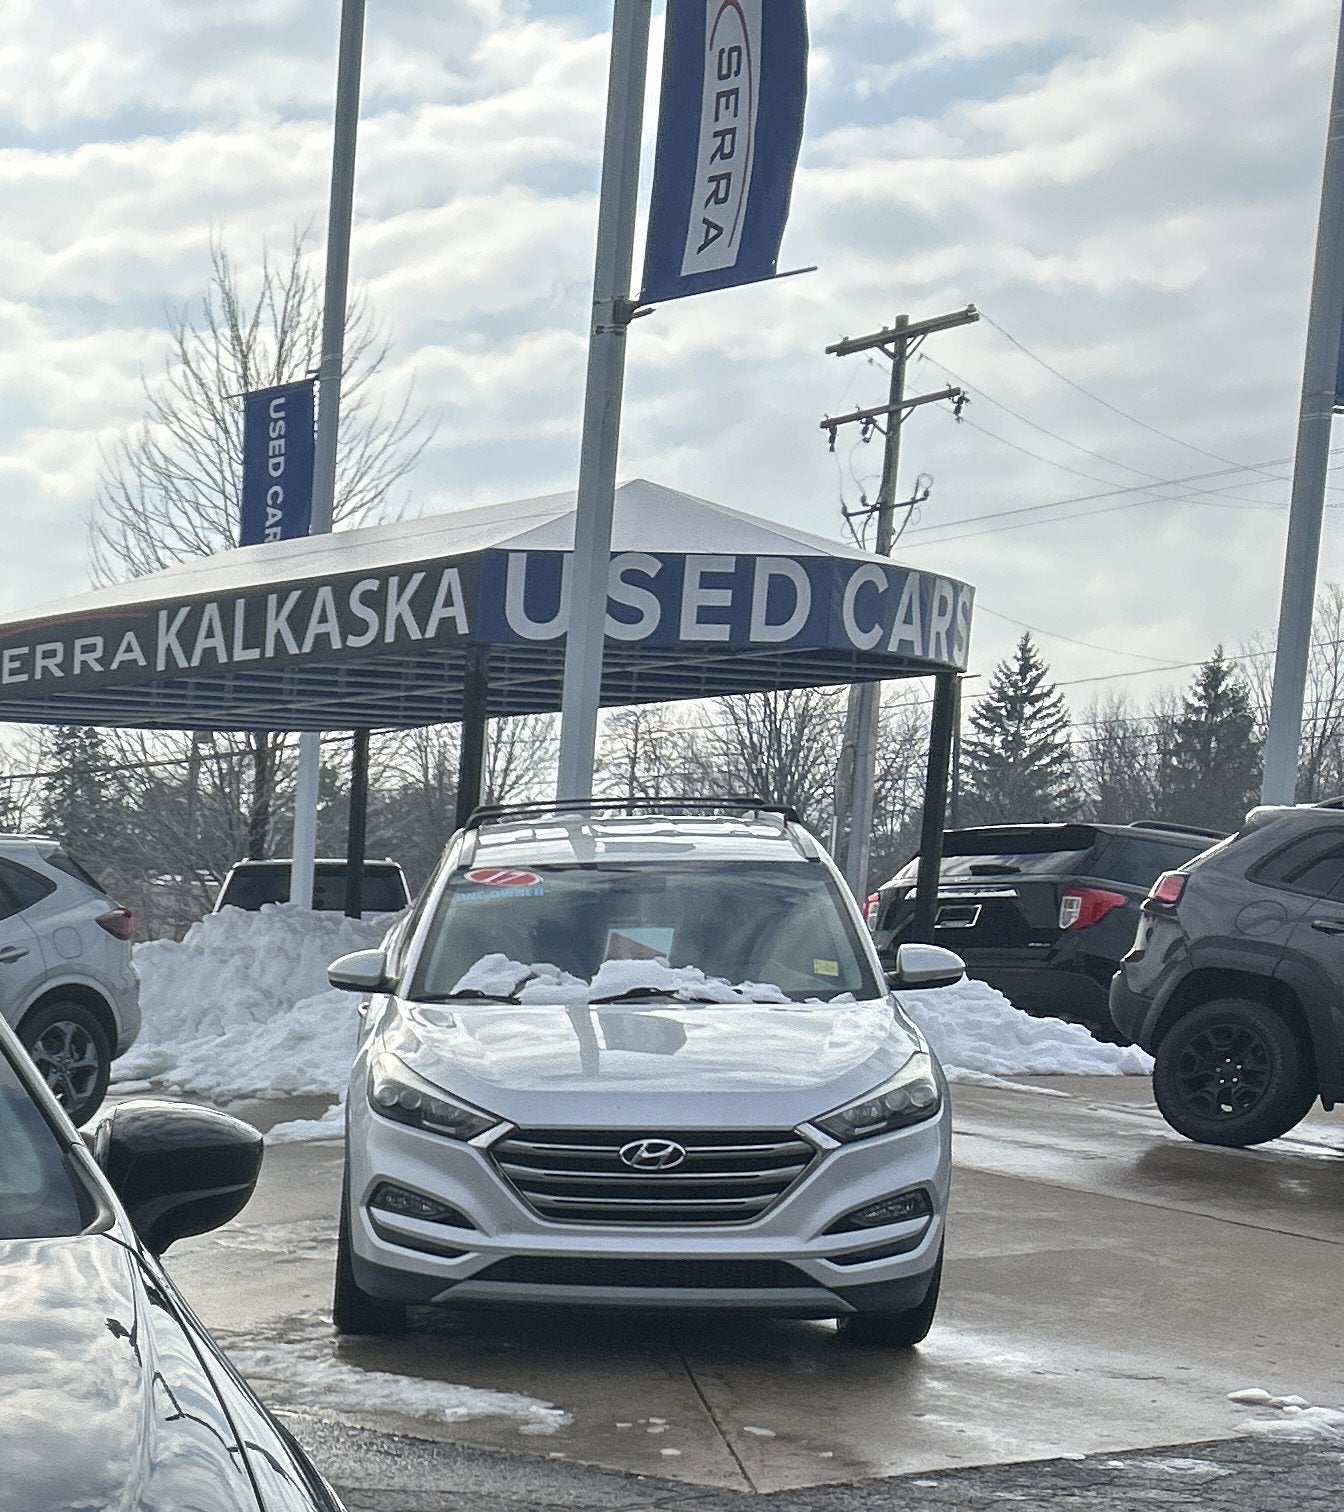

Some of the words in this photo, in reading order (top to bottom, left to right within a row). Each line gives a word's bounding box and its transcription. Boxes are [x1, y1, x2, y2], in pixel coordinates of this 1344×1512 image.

[697, 45, 742, 255] SERRA
[268, 397, 285, 477] USED
[264, 484, 285, 544] CAR
[156, 568, 469, 670] KALKASKA
[505, 552, 811, 643] USED
[842, 563, 975, 667] CARS
